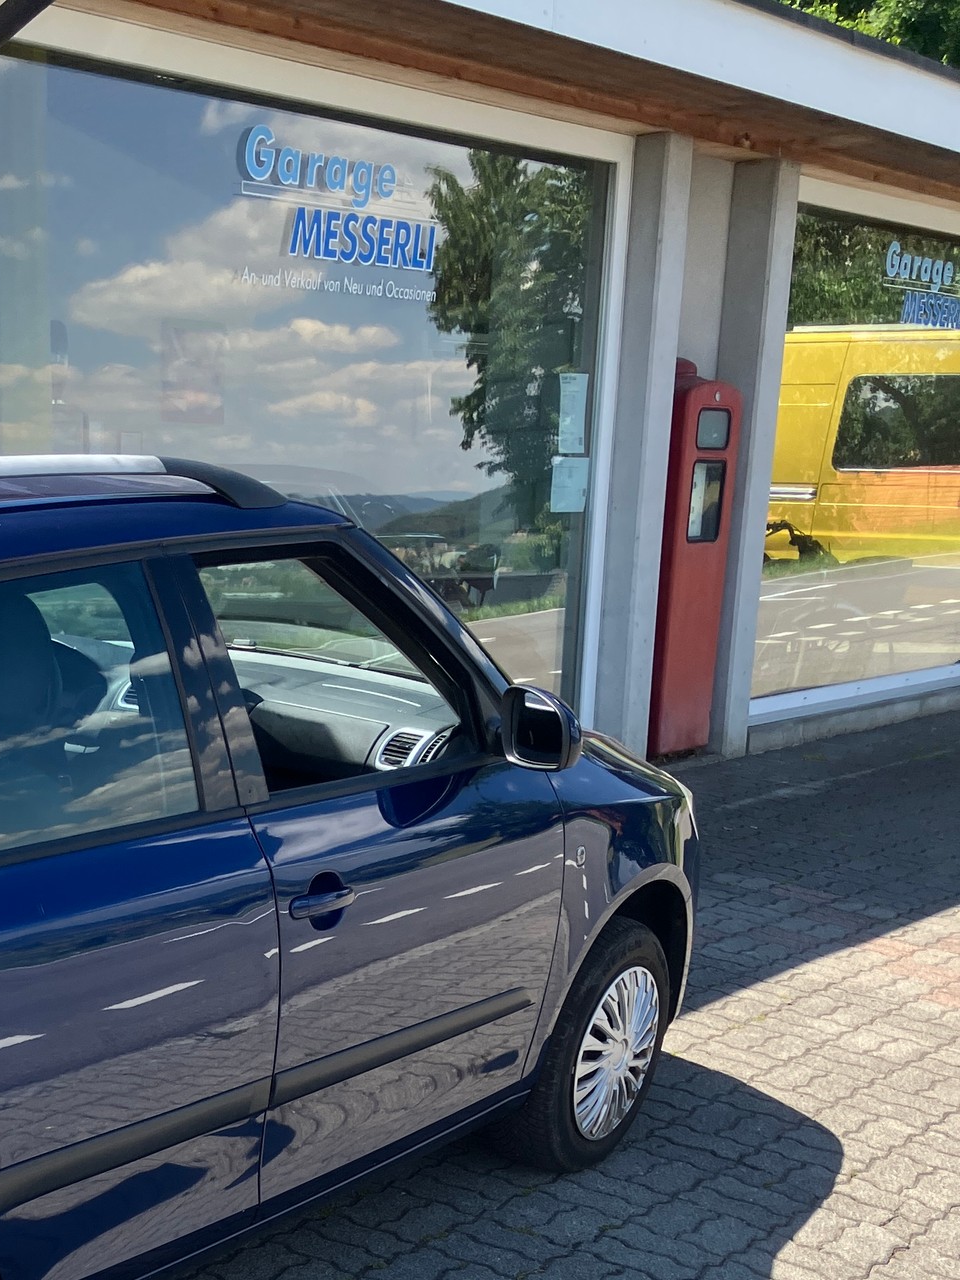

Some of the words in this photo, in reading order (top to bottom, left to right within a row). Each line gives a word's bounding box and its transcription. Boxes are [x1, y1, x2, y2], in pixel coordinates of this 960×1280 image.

[245, 124, 397, 209] Garage
[289, 207, 436, 272] MESSERLI
[261, 269, 281, 287] und
[284, 270, 322, 291] Verkauf
[323, 278, 340, 293] von
[343, 276, 363, 295] Neu
[365, 278, 383, 297] und
[385, 281, 437, 302] Occasionen
[886, 240, 954, 293] Garage
[900, 290, 960, 329] MESSER
